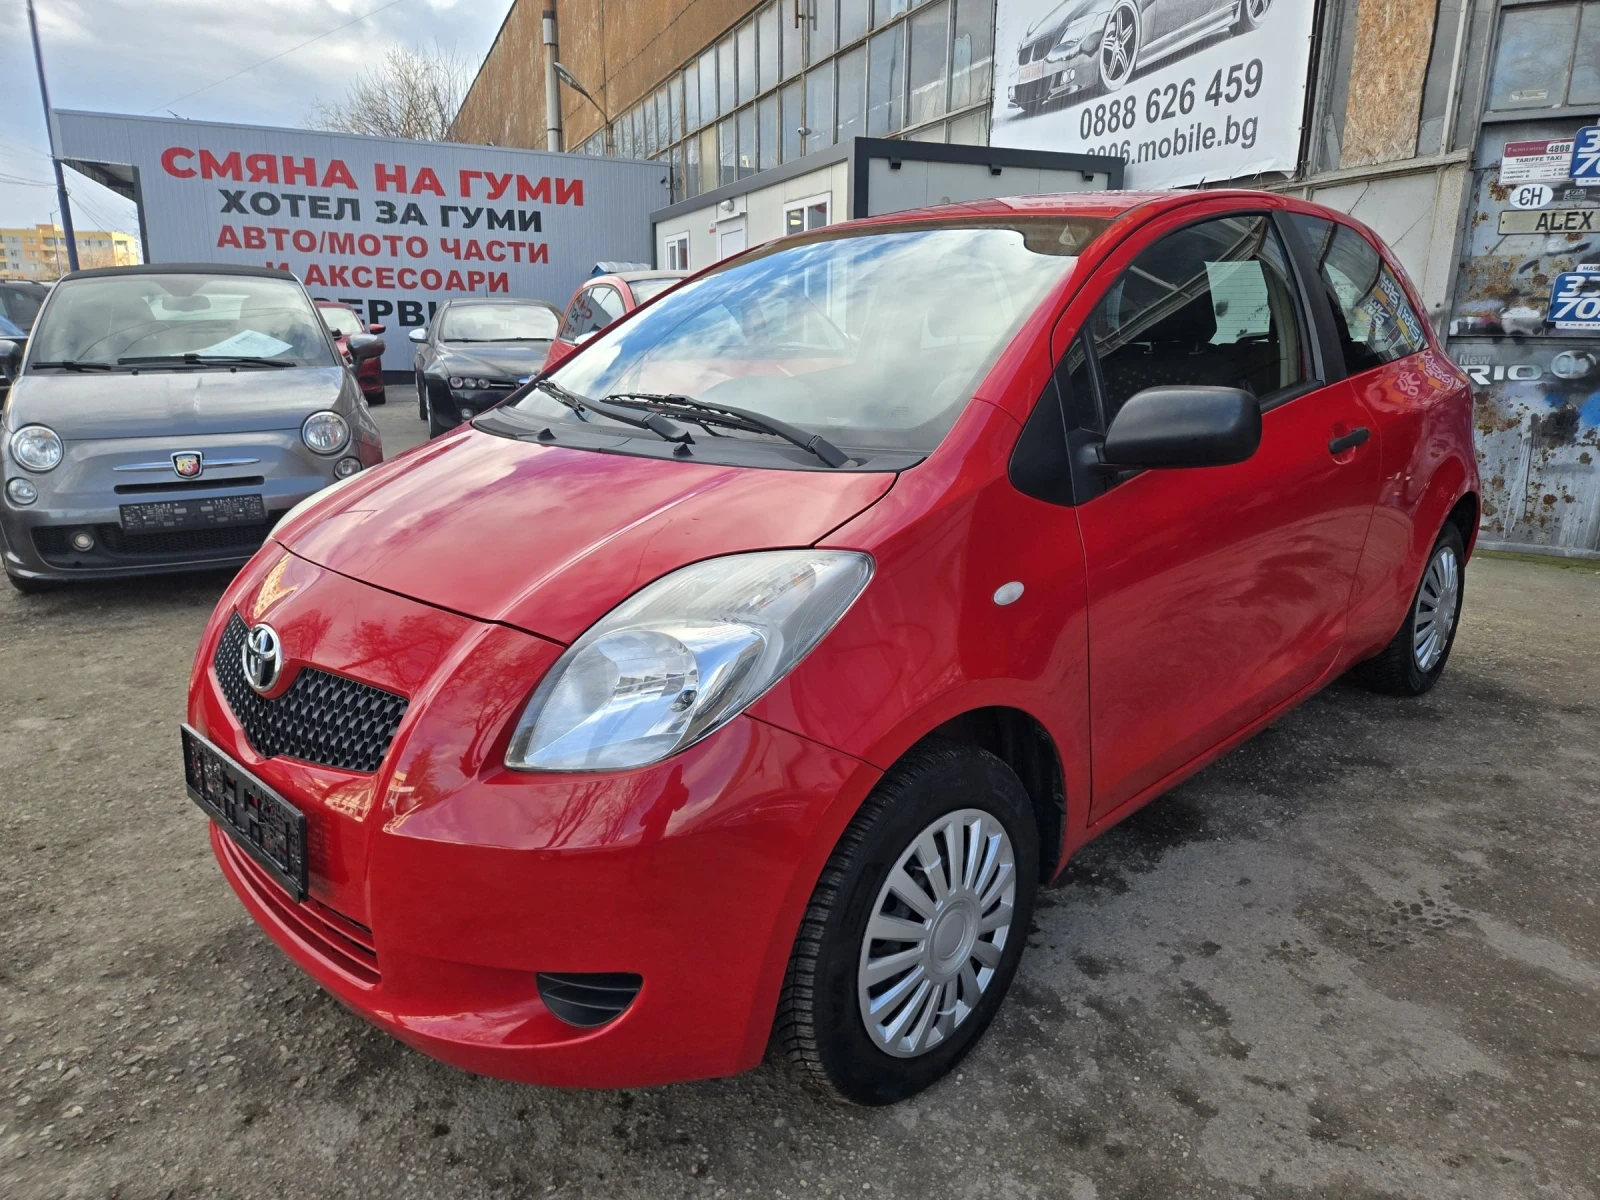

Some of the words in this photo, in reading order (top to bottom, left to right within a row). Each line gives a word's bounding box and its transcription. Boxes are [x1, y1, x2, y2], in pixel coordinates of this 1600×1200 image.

[1079, 95, 1136, 140] 0888
[1145, 77, 1196, 124] 626
[1204, 58, 1263, 107] 459
[161, 147, 357, 190] СМЯНА
[374, 163, 445, 197] НА
[459, 170, 584, 207] ГУМИ
[218, 189, 361, 222] ХОТЕЛ
[374, 200, 428, 226] ЗА
[440, 205, 542, 233] ГУМИ
[1518, 187, 1543, 206] CH
[1535, 211, 1595, 232] ALEX
[217, 225, 428, 258] АВТО/МОТО
[440, 238, 548, 264] ЧАСТИ
[304, 263, 510, 293] АКСЕСОАРИ
[1460, 354, 1491, 365] New
[1460, 364, 1543, 385] RIO
